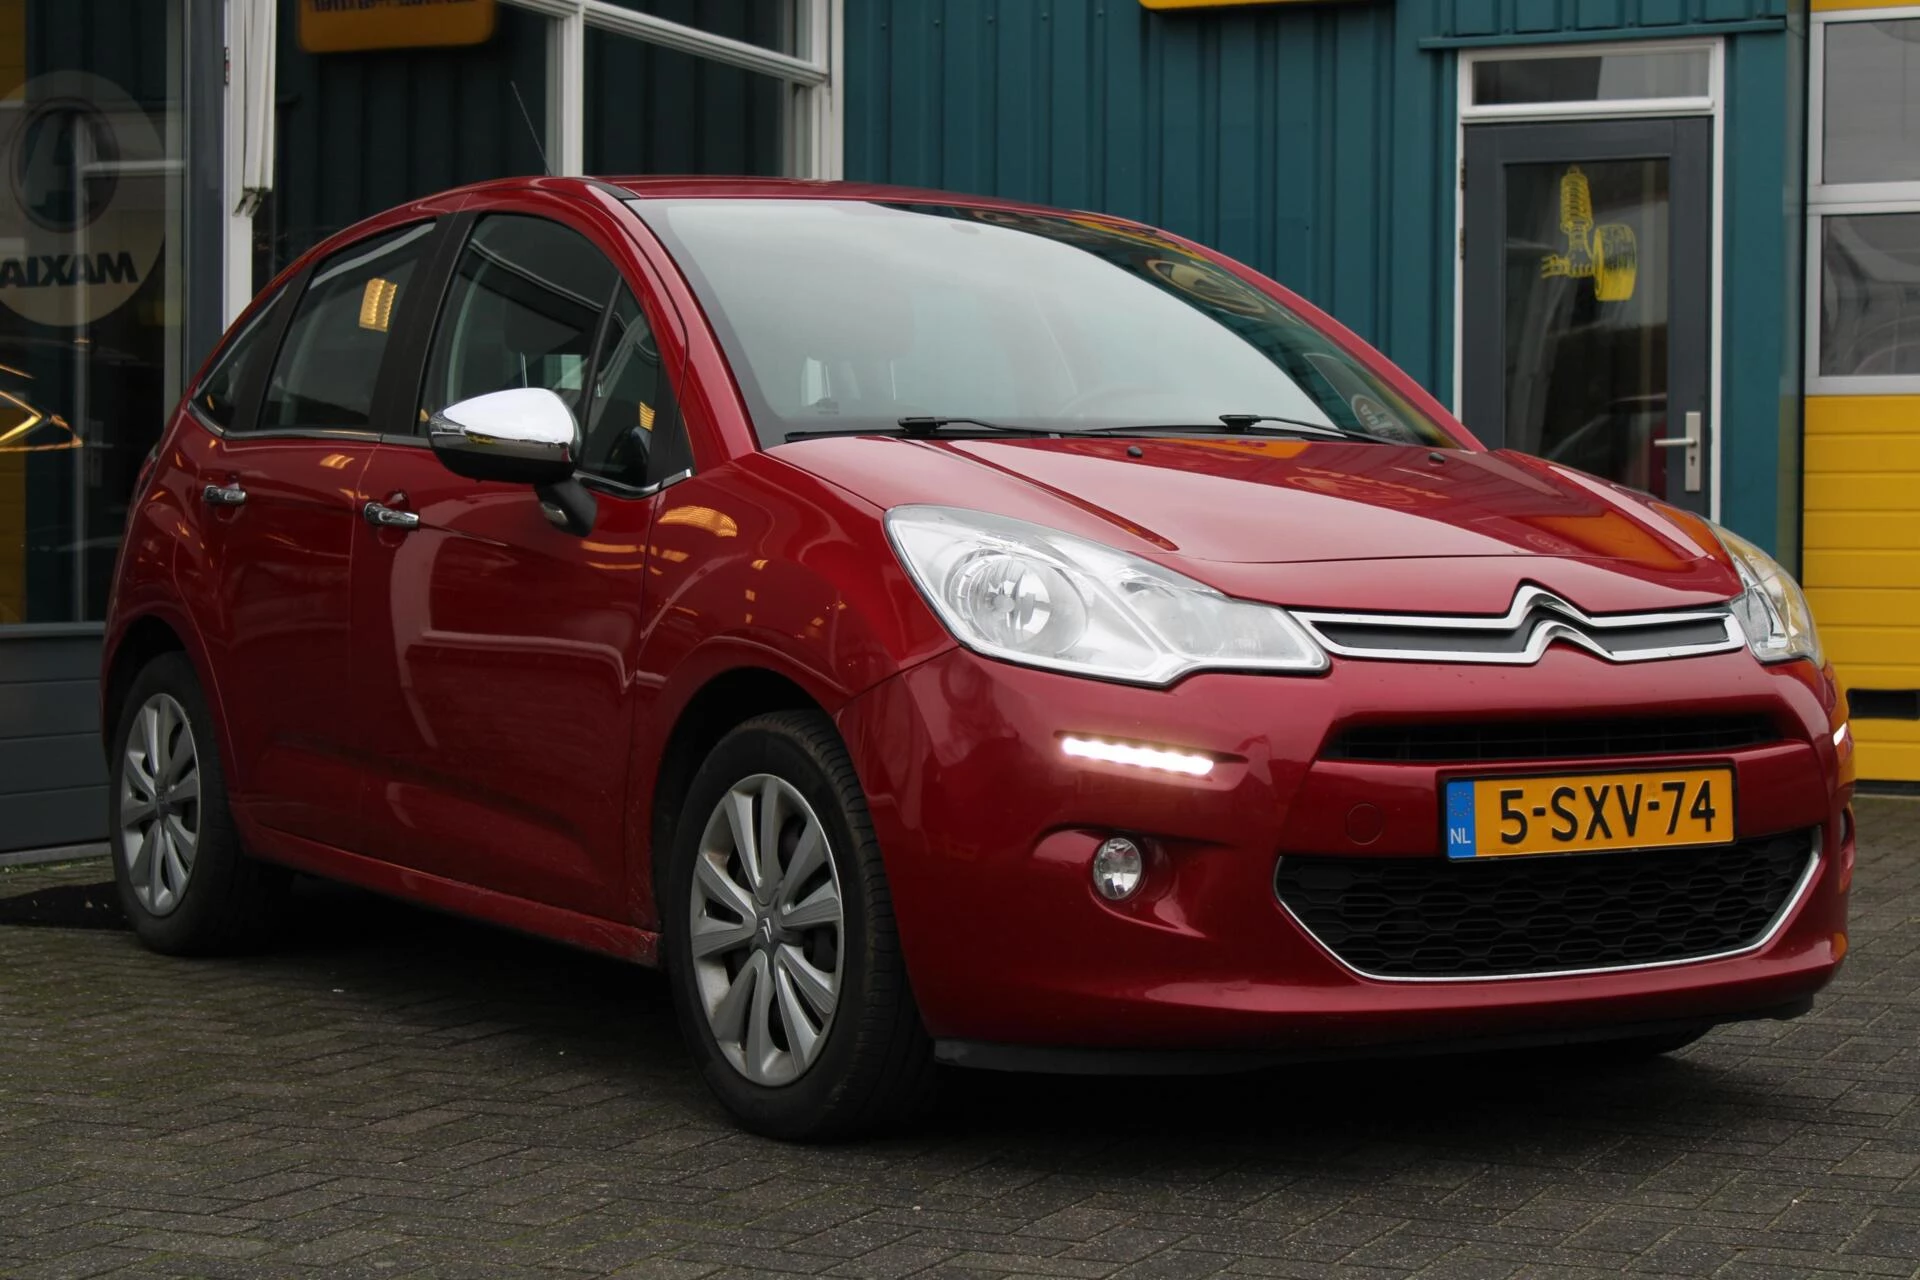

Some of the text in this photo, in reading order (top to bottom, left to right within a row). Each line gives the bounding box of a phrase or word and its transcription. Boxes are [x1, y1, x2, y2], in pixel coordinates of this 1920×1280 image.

[0, 251, 139, 288] AIXAM
[1499, 779, 1716, 845] 5-SXV-74
[1450, 827, 1471, 845] NL
